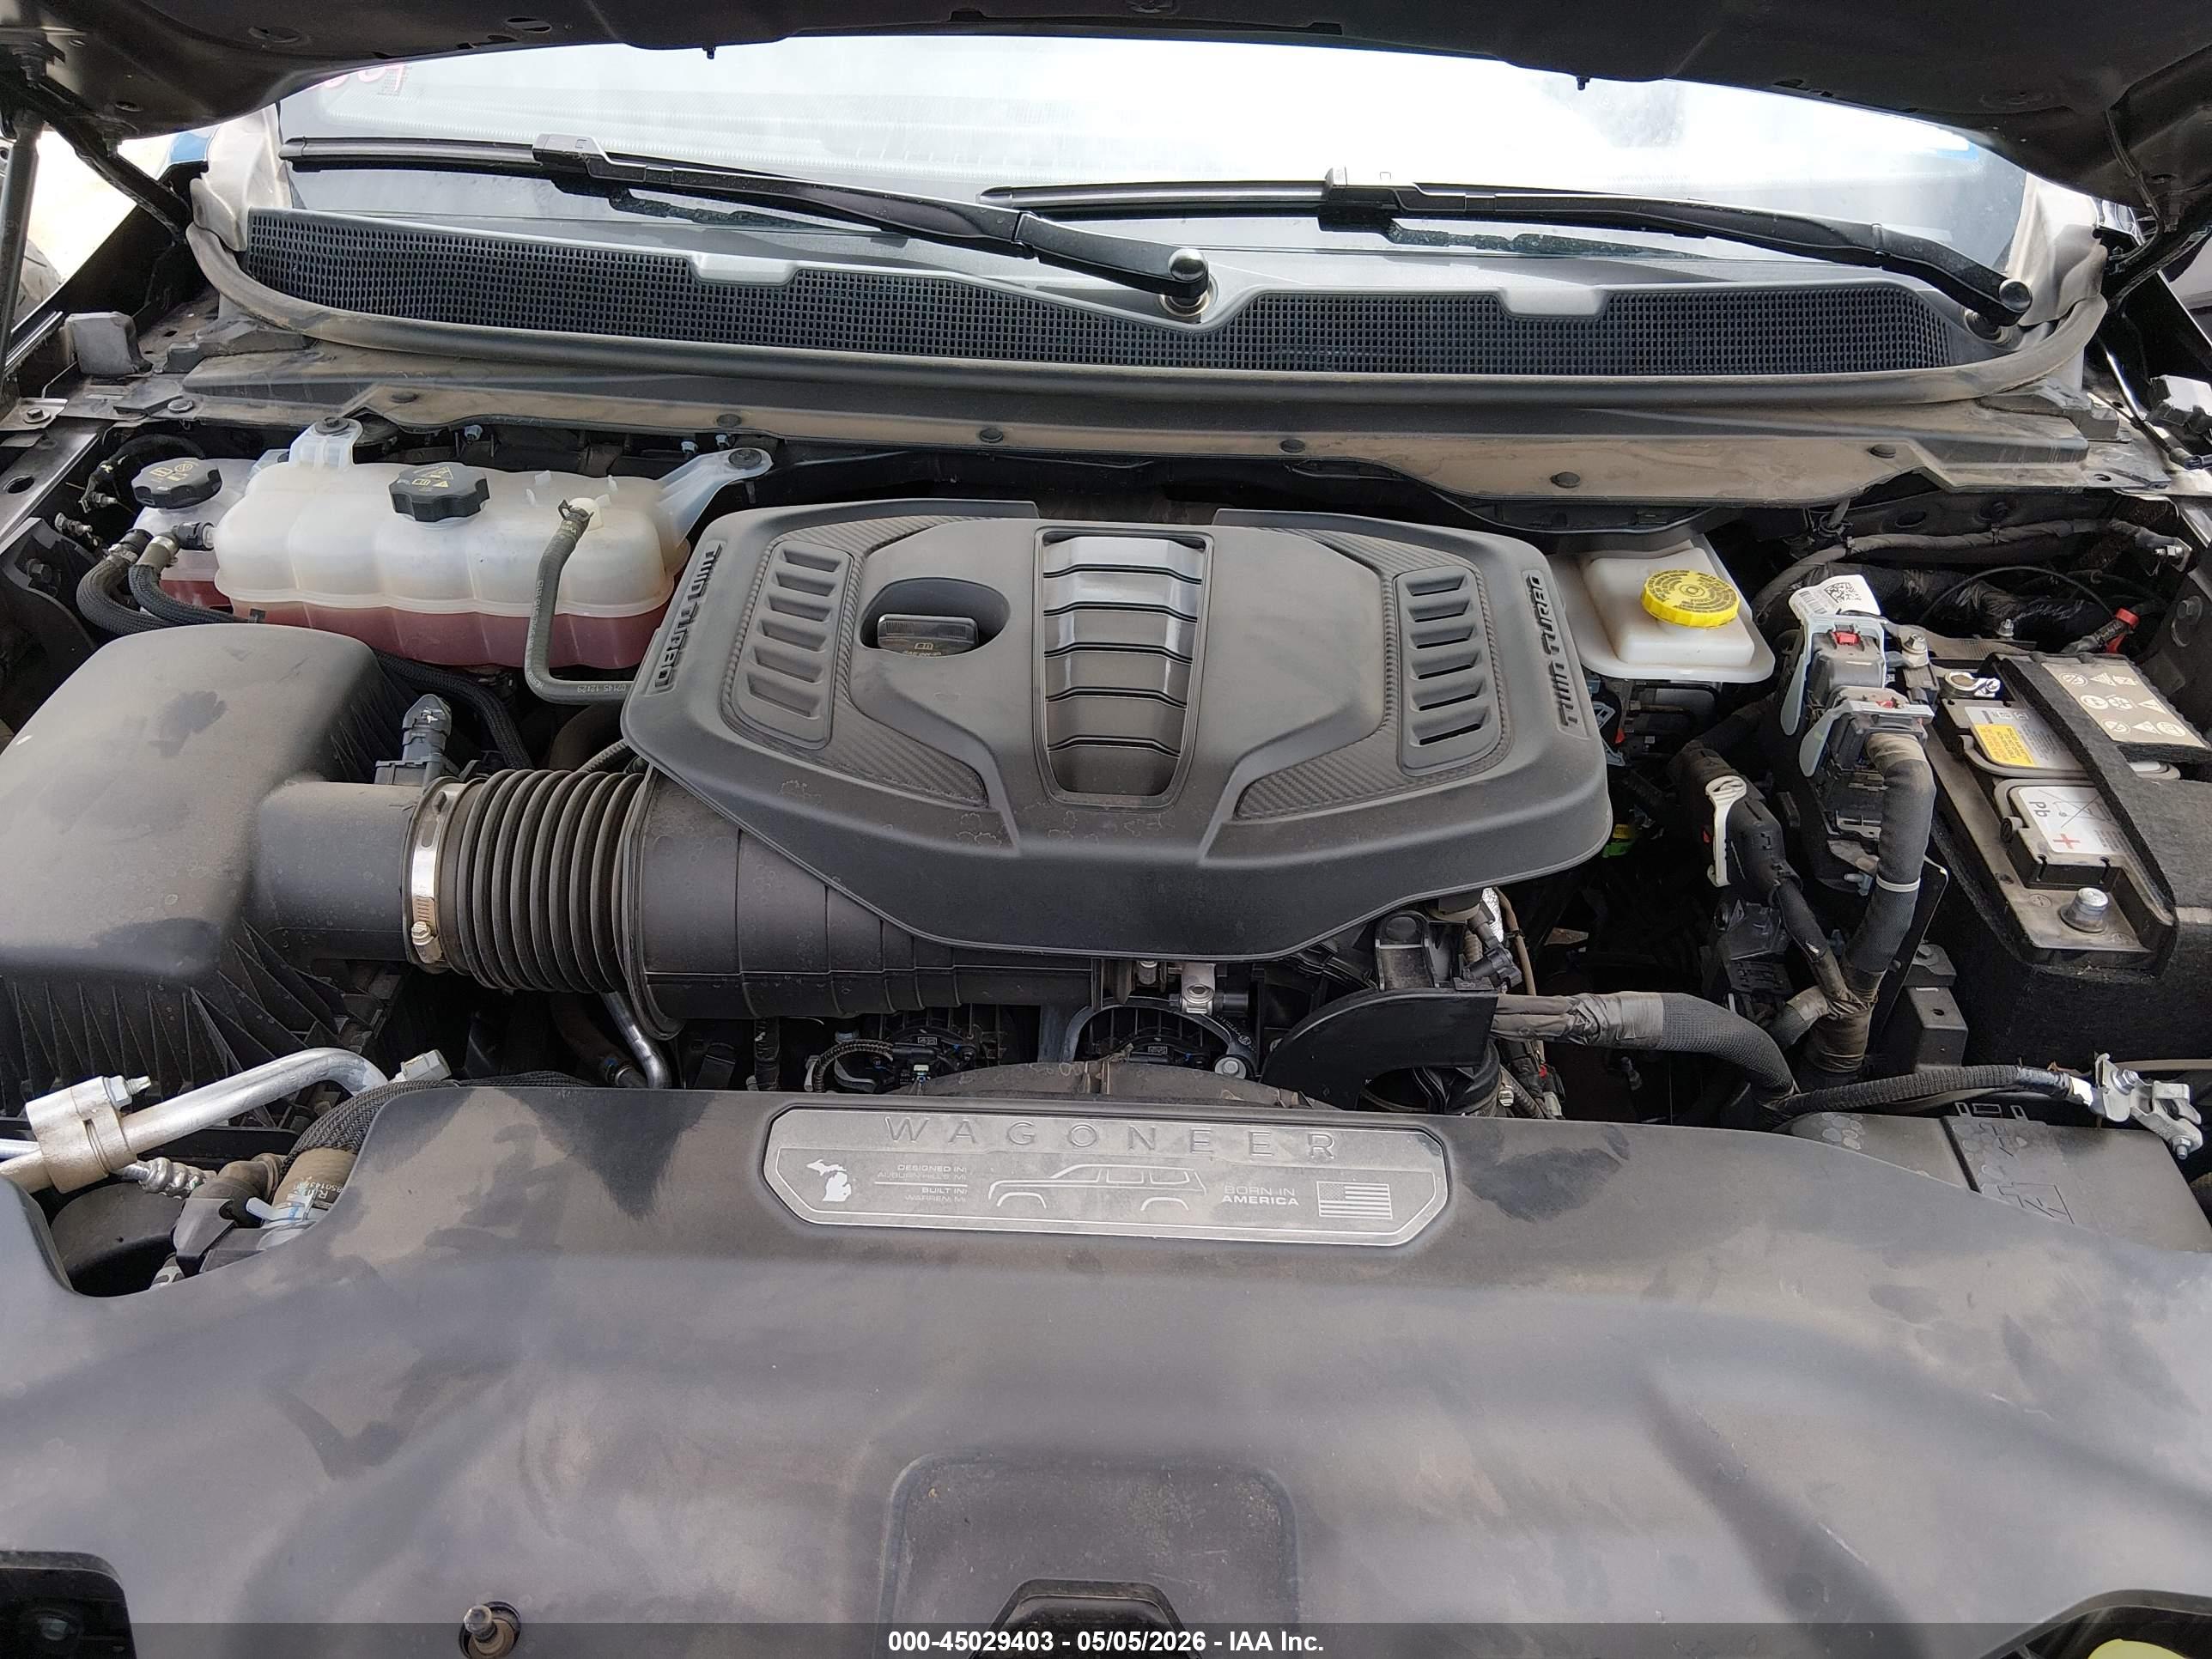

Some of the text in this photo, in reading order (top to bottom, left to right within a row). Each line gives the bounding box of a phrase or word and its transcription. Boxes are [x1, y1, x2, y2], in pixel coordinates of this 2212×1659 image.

[655, 601, 699, 688] TURBO
[1526, 574, 1578, 727] TWIN TURBO
[2029, 801, 2051, 817] Pb
[884, 1115, 1335, 1161] WAGONEER
[877, 1170, 921, 1180] AUBURN
[897, 1164, 951, 1173] DESIGNED
[1224, 1184, 1296, 1197] BORN IN
[1221, 1194, 1300, 1206] AMERICA
